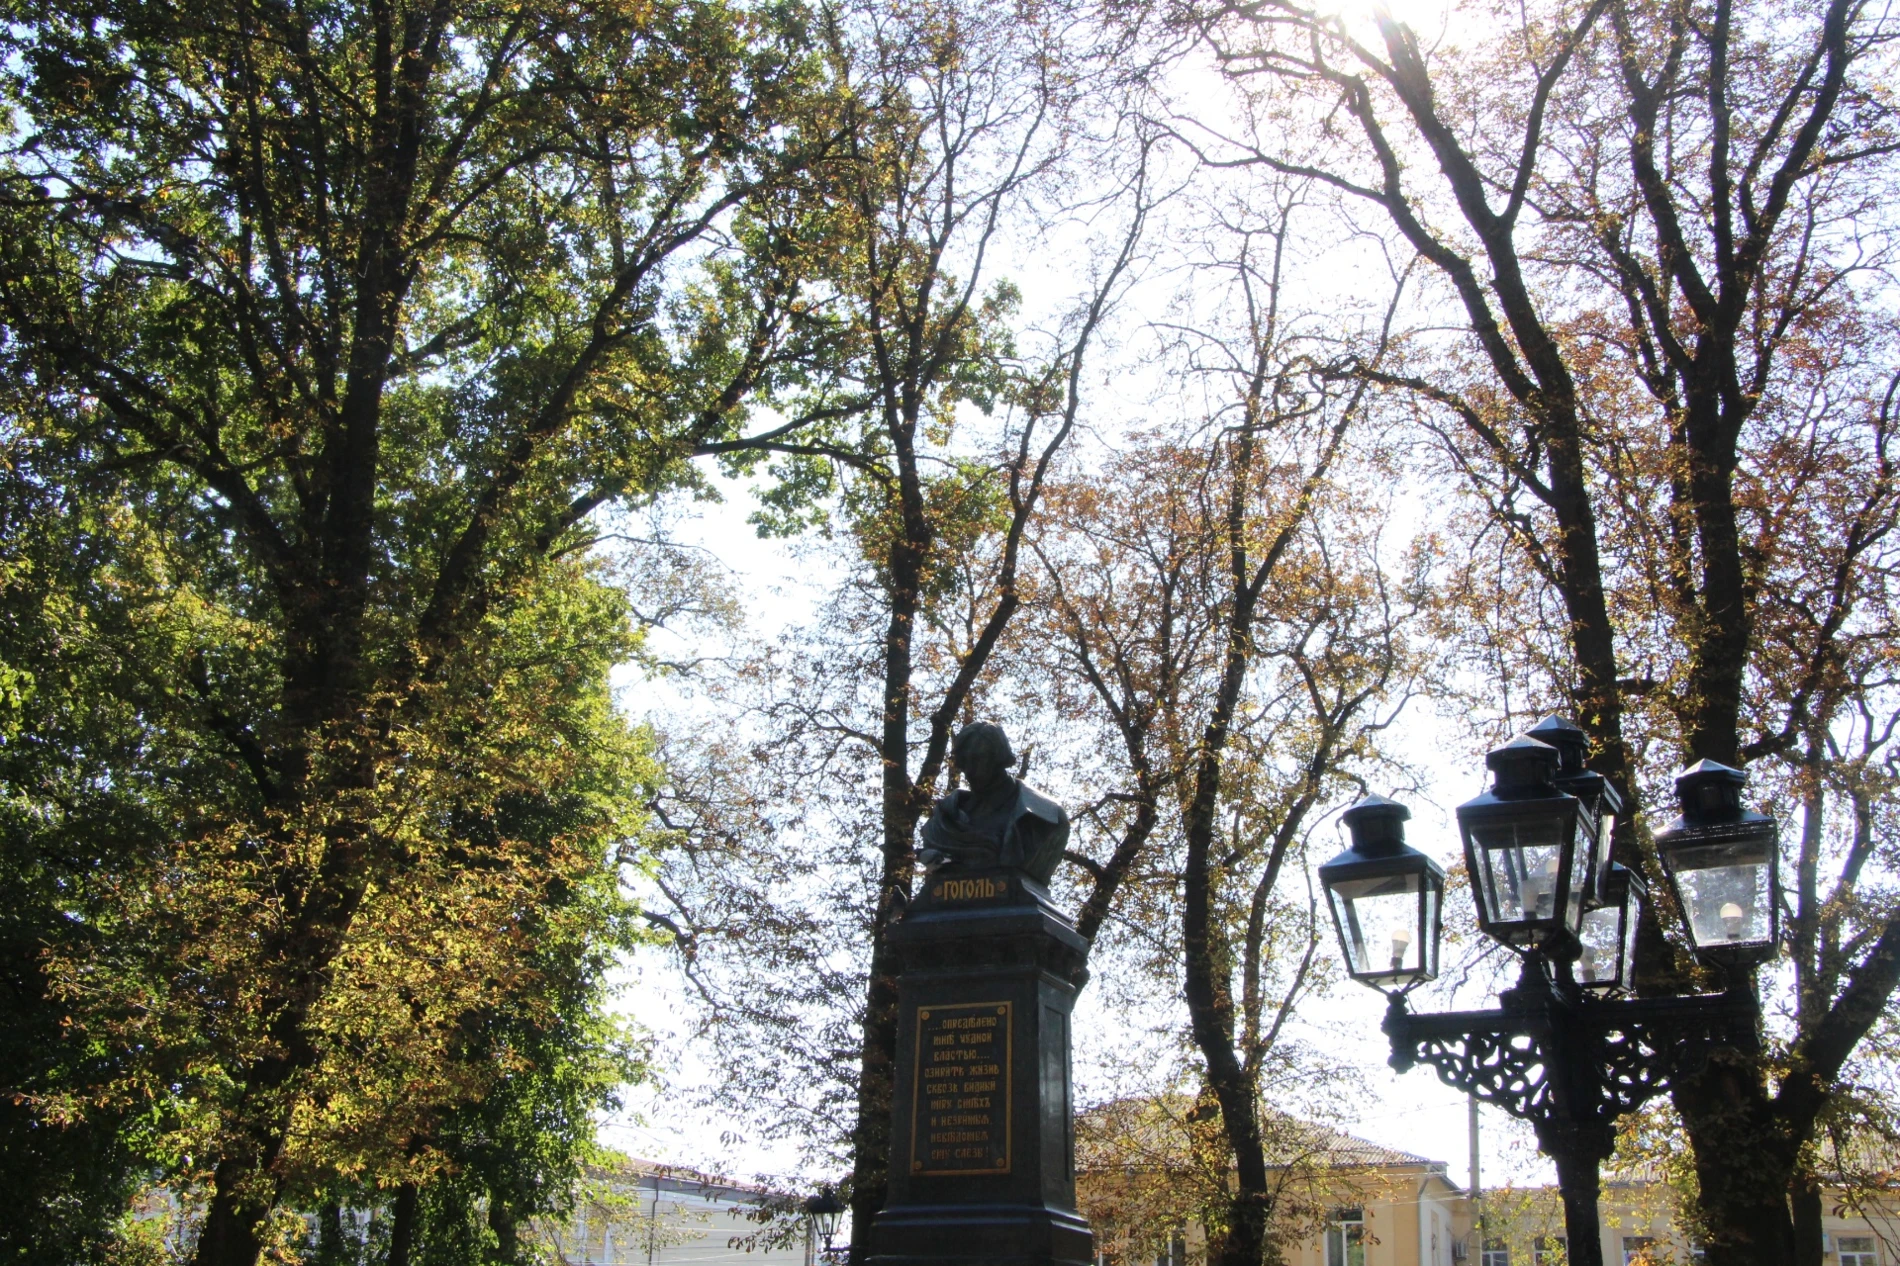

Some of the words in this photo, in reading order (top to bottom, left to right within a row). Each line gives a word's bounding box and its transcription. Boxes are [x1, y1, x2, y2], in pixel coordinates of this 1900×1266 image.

[943, 878, 995, 900] ГОГОЛЬ
[969, 1062, 999, 1076] ЖИЗНЬ
[926, 1081, 958, 1095] СКВОЗЬ
[931, 1117, 937, 1127] И
